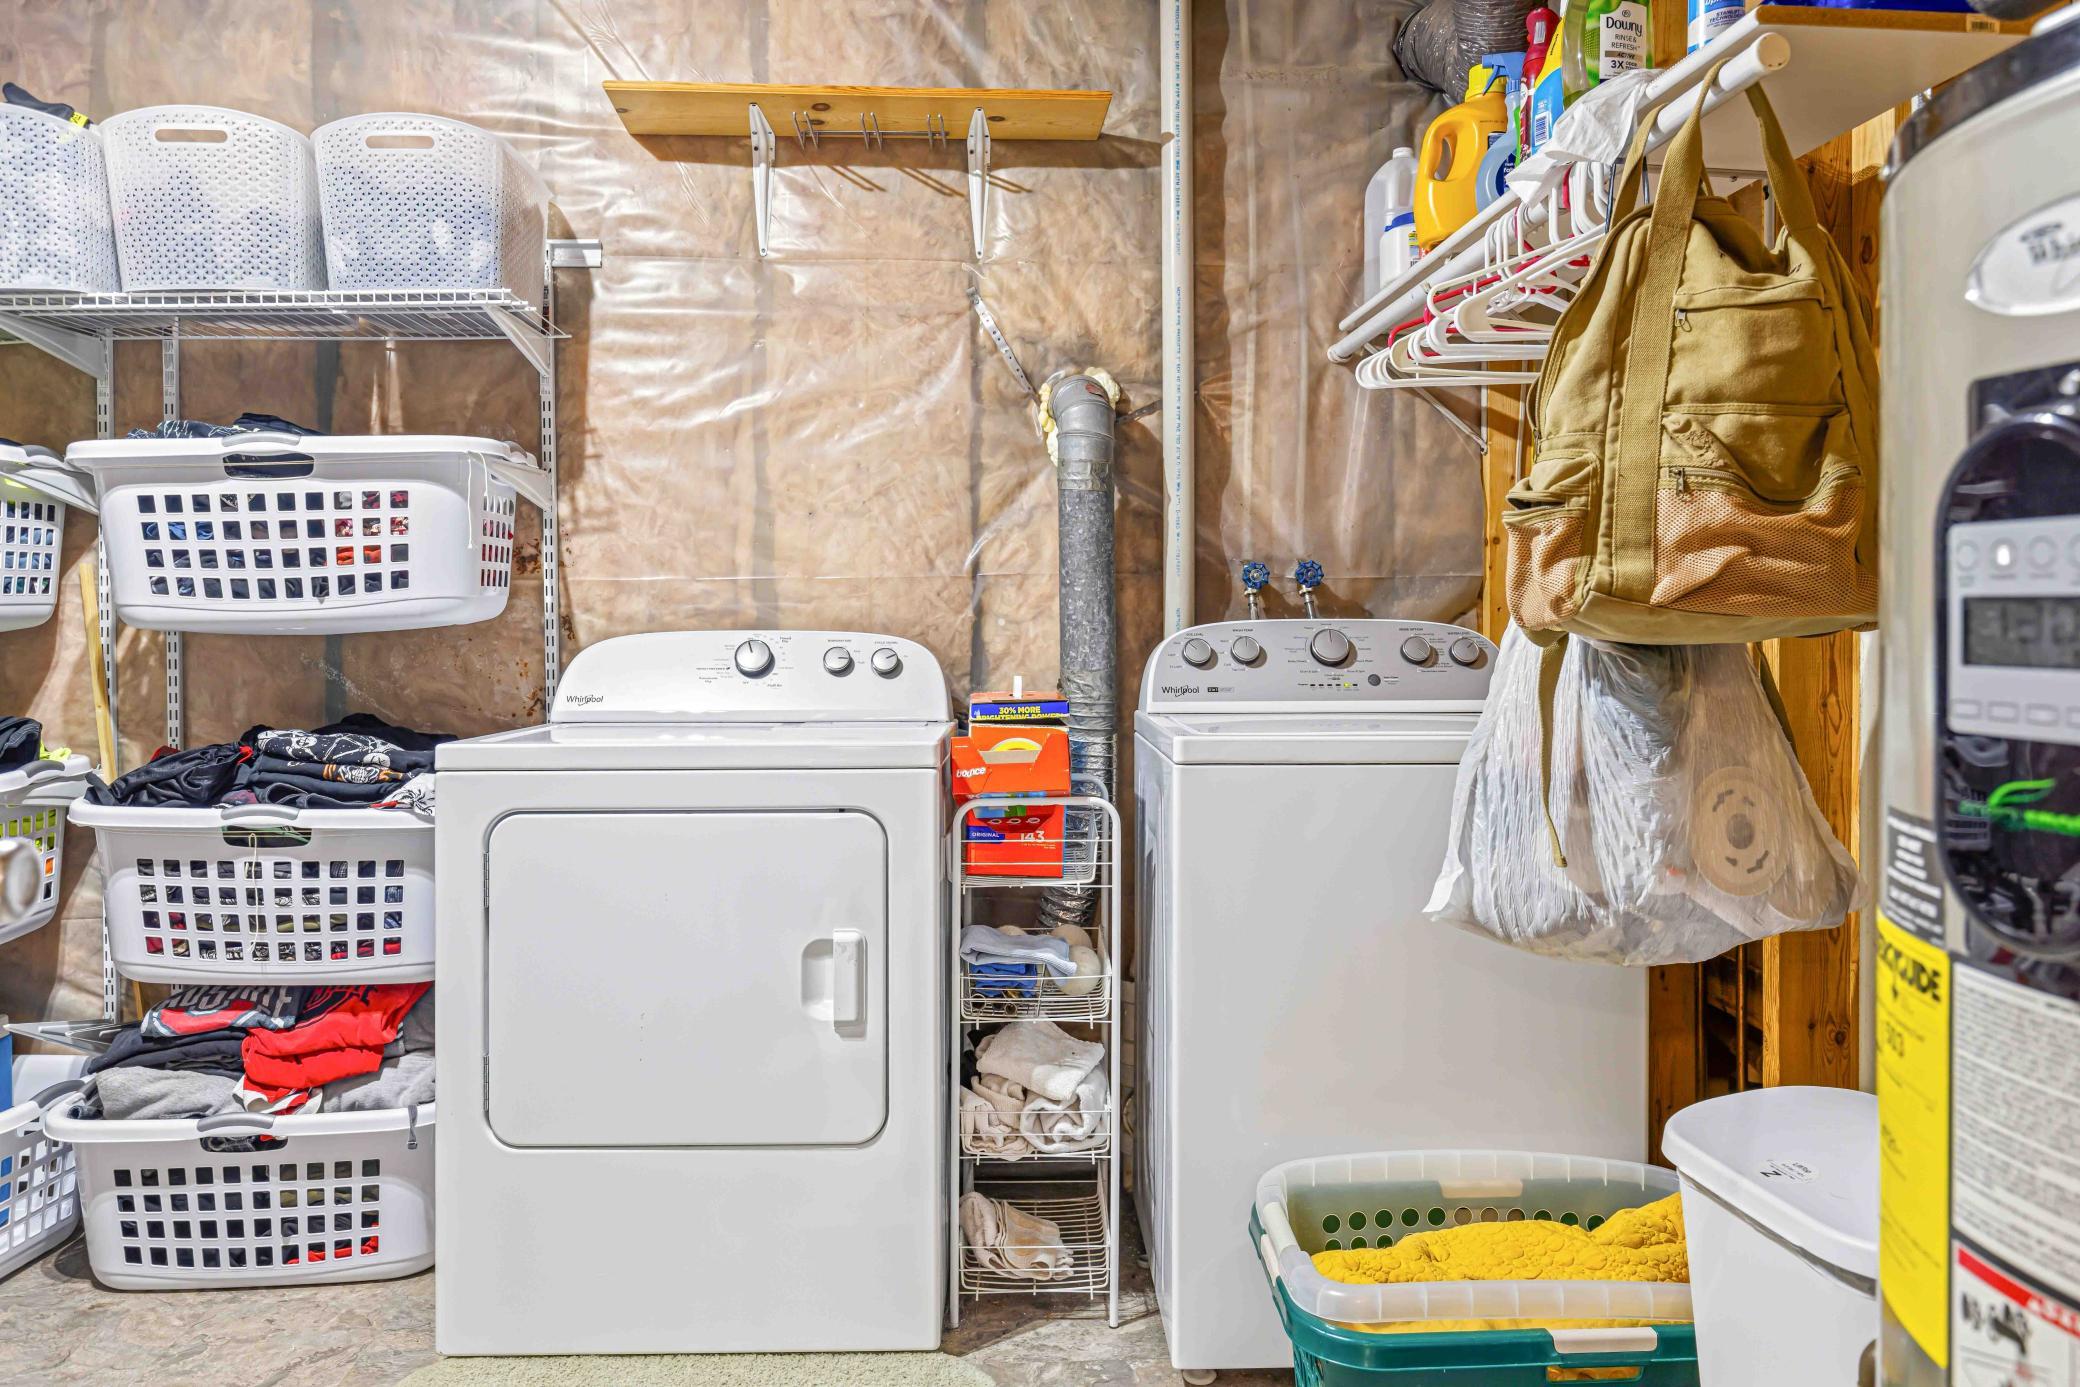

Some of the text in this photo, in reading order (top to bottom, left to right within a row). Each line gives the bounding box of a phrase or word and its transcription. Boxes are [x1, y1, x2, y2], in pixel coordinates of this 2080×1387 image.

[1606, 16, 1643, 38] Downy
[1610, 60, 1624, 70] 3X
[1162, 685, 1200, 697] Whirlpool
[566, 694, 604, 706] Whirlpool
[956, 767, 986, 778] bounce
[1020, 830, 1045, 842] 143
